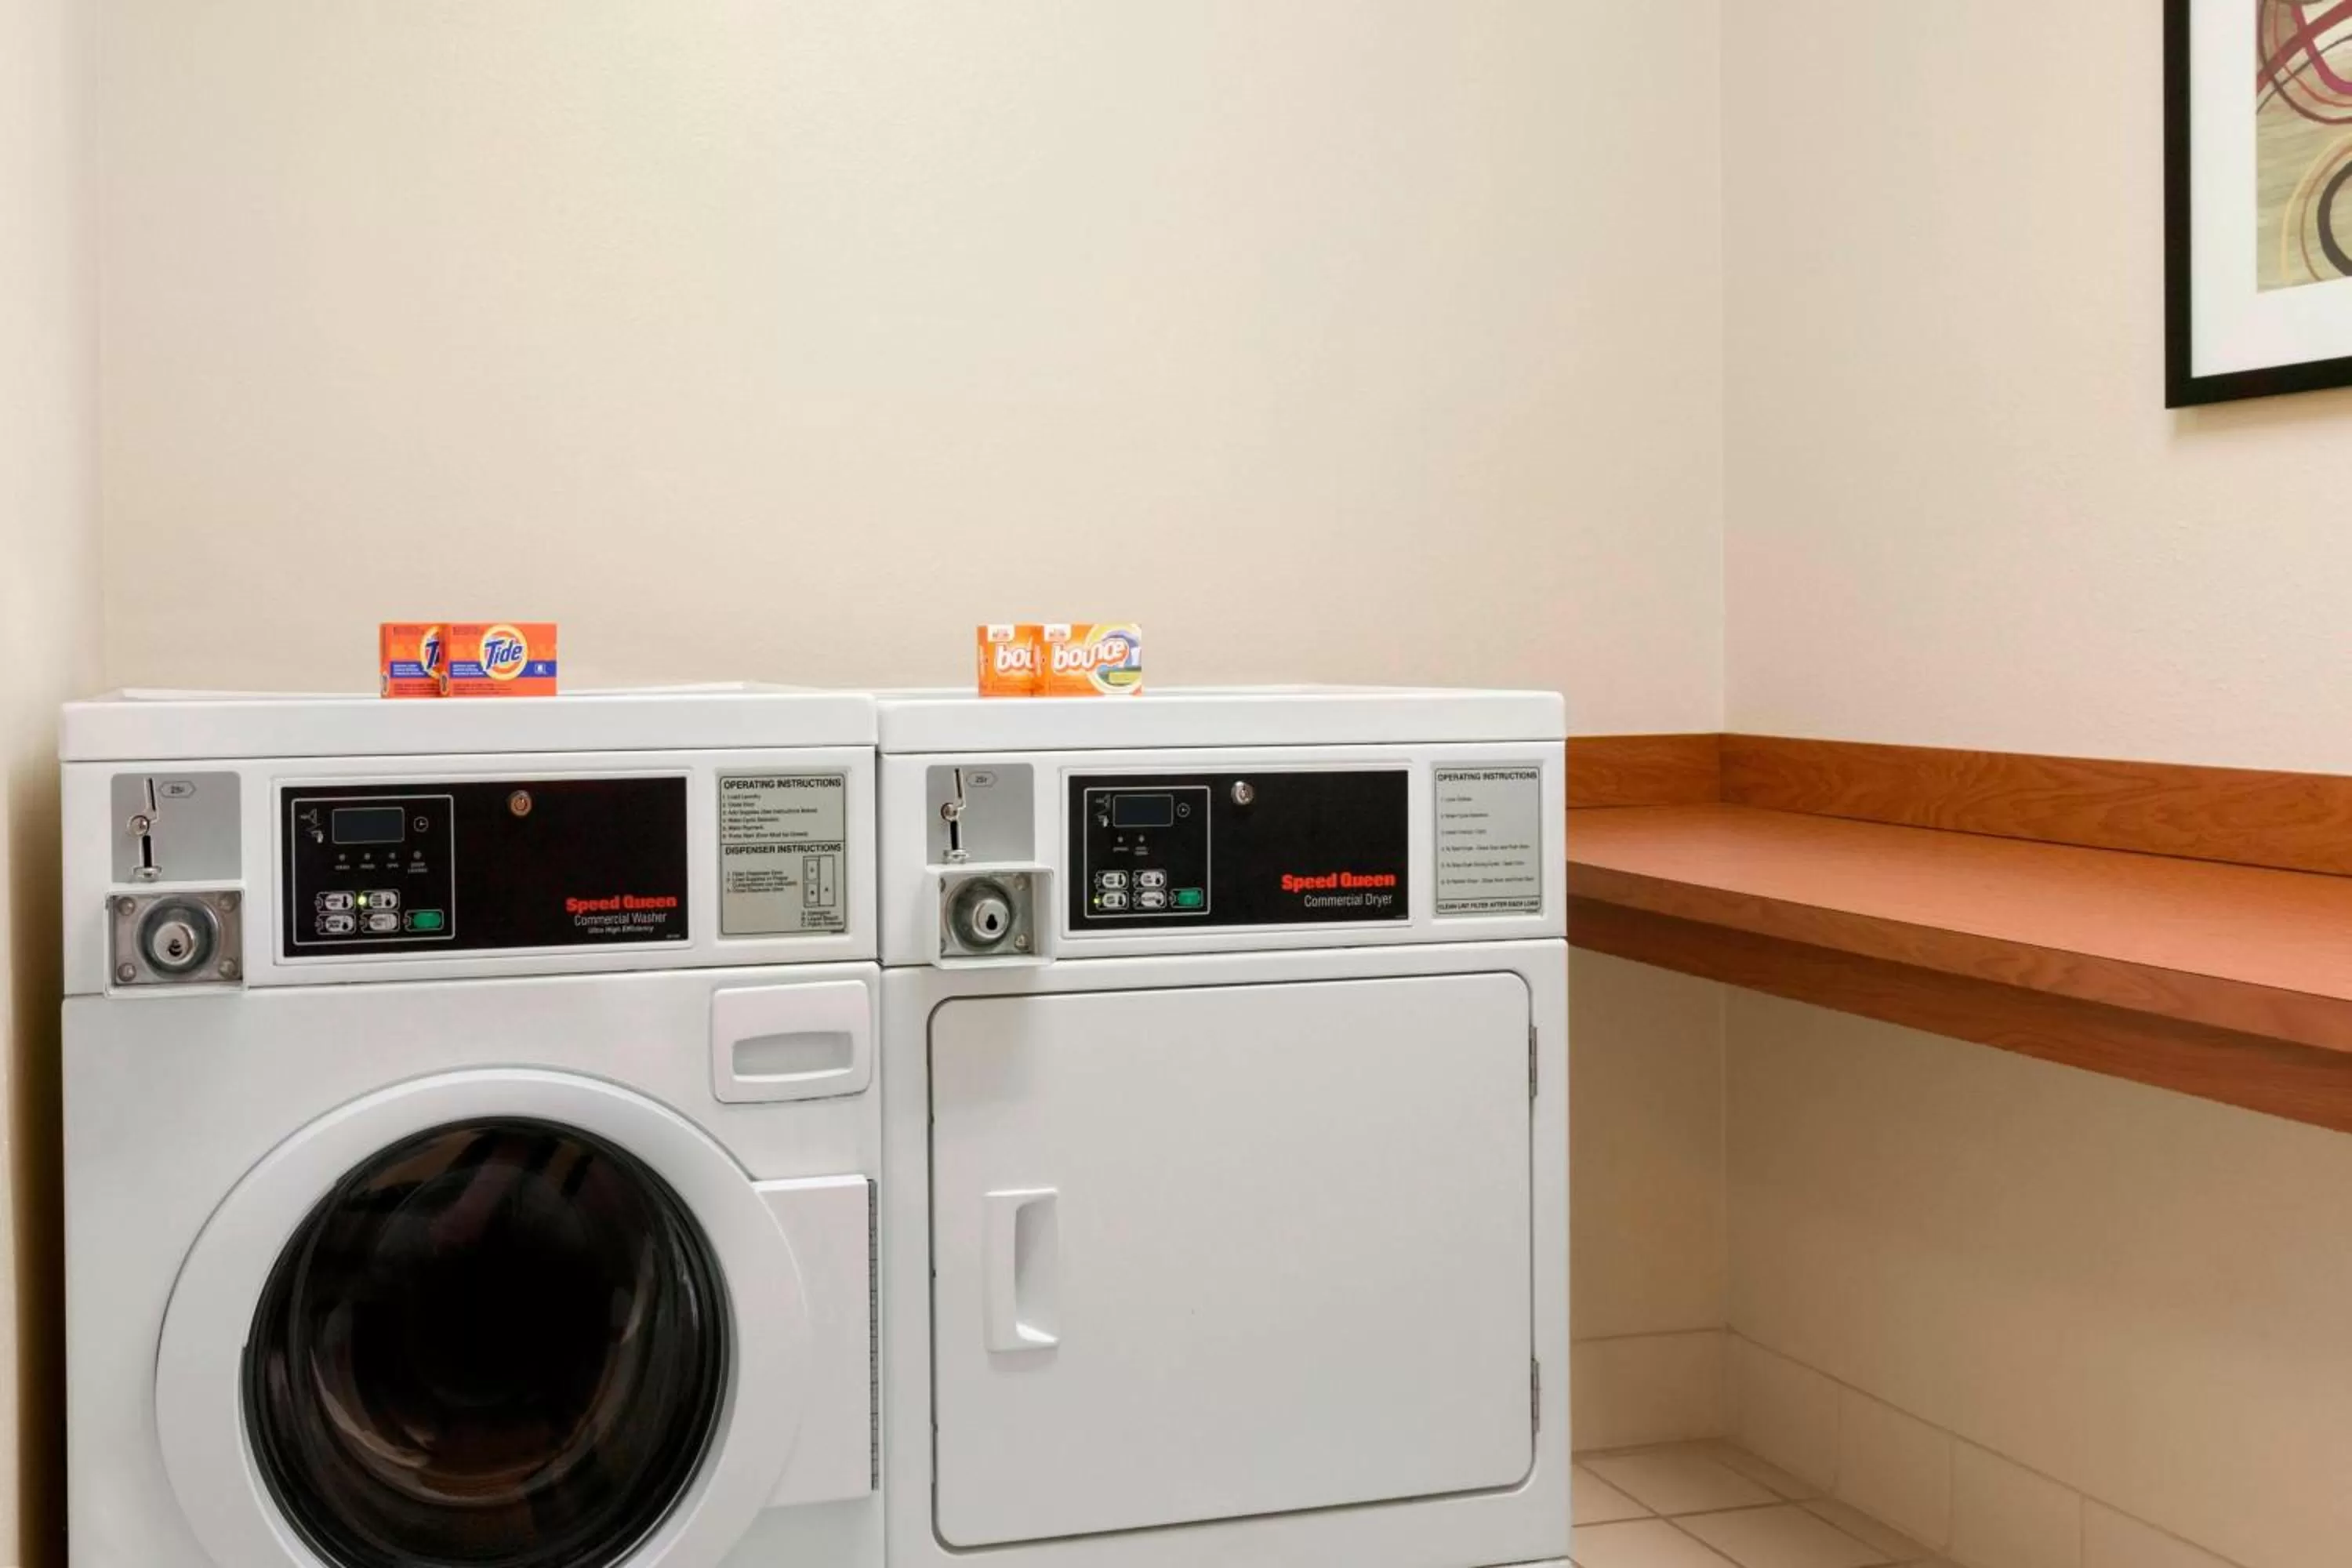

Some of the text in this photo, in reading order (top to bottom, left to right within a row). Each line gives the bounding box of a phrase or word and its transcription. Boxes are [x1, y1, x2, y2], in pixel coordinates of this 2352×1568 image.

[484, 639, 523, 670] Tide
[1052, 639, 1125, 670] bounce
[724, 778, 841, 789] OPERATING INSTRUCTIONS
[1437, 771, 1537, 782] OPERATING INSTRUCTIONS
[725, 844, 841, 855] DISPENSER INSTRUCTIONS
[1282, 872, 1396, 892] Speed Queen
[565, 895, 677, 913] Speed Queen
[1304, 893, 1392, 908] Commercial Dryer
[574, 912, 667, 927] Commercial Washer
